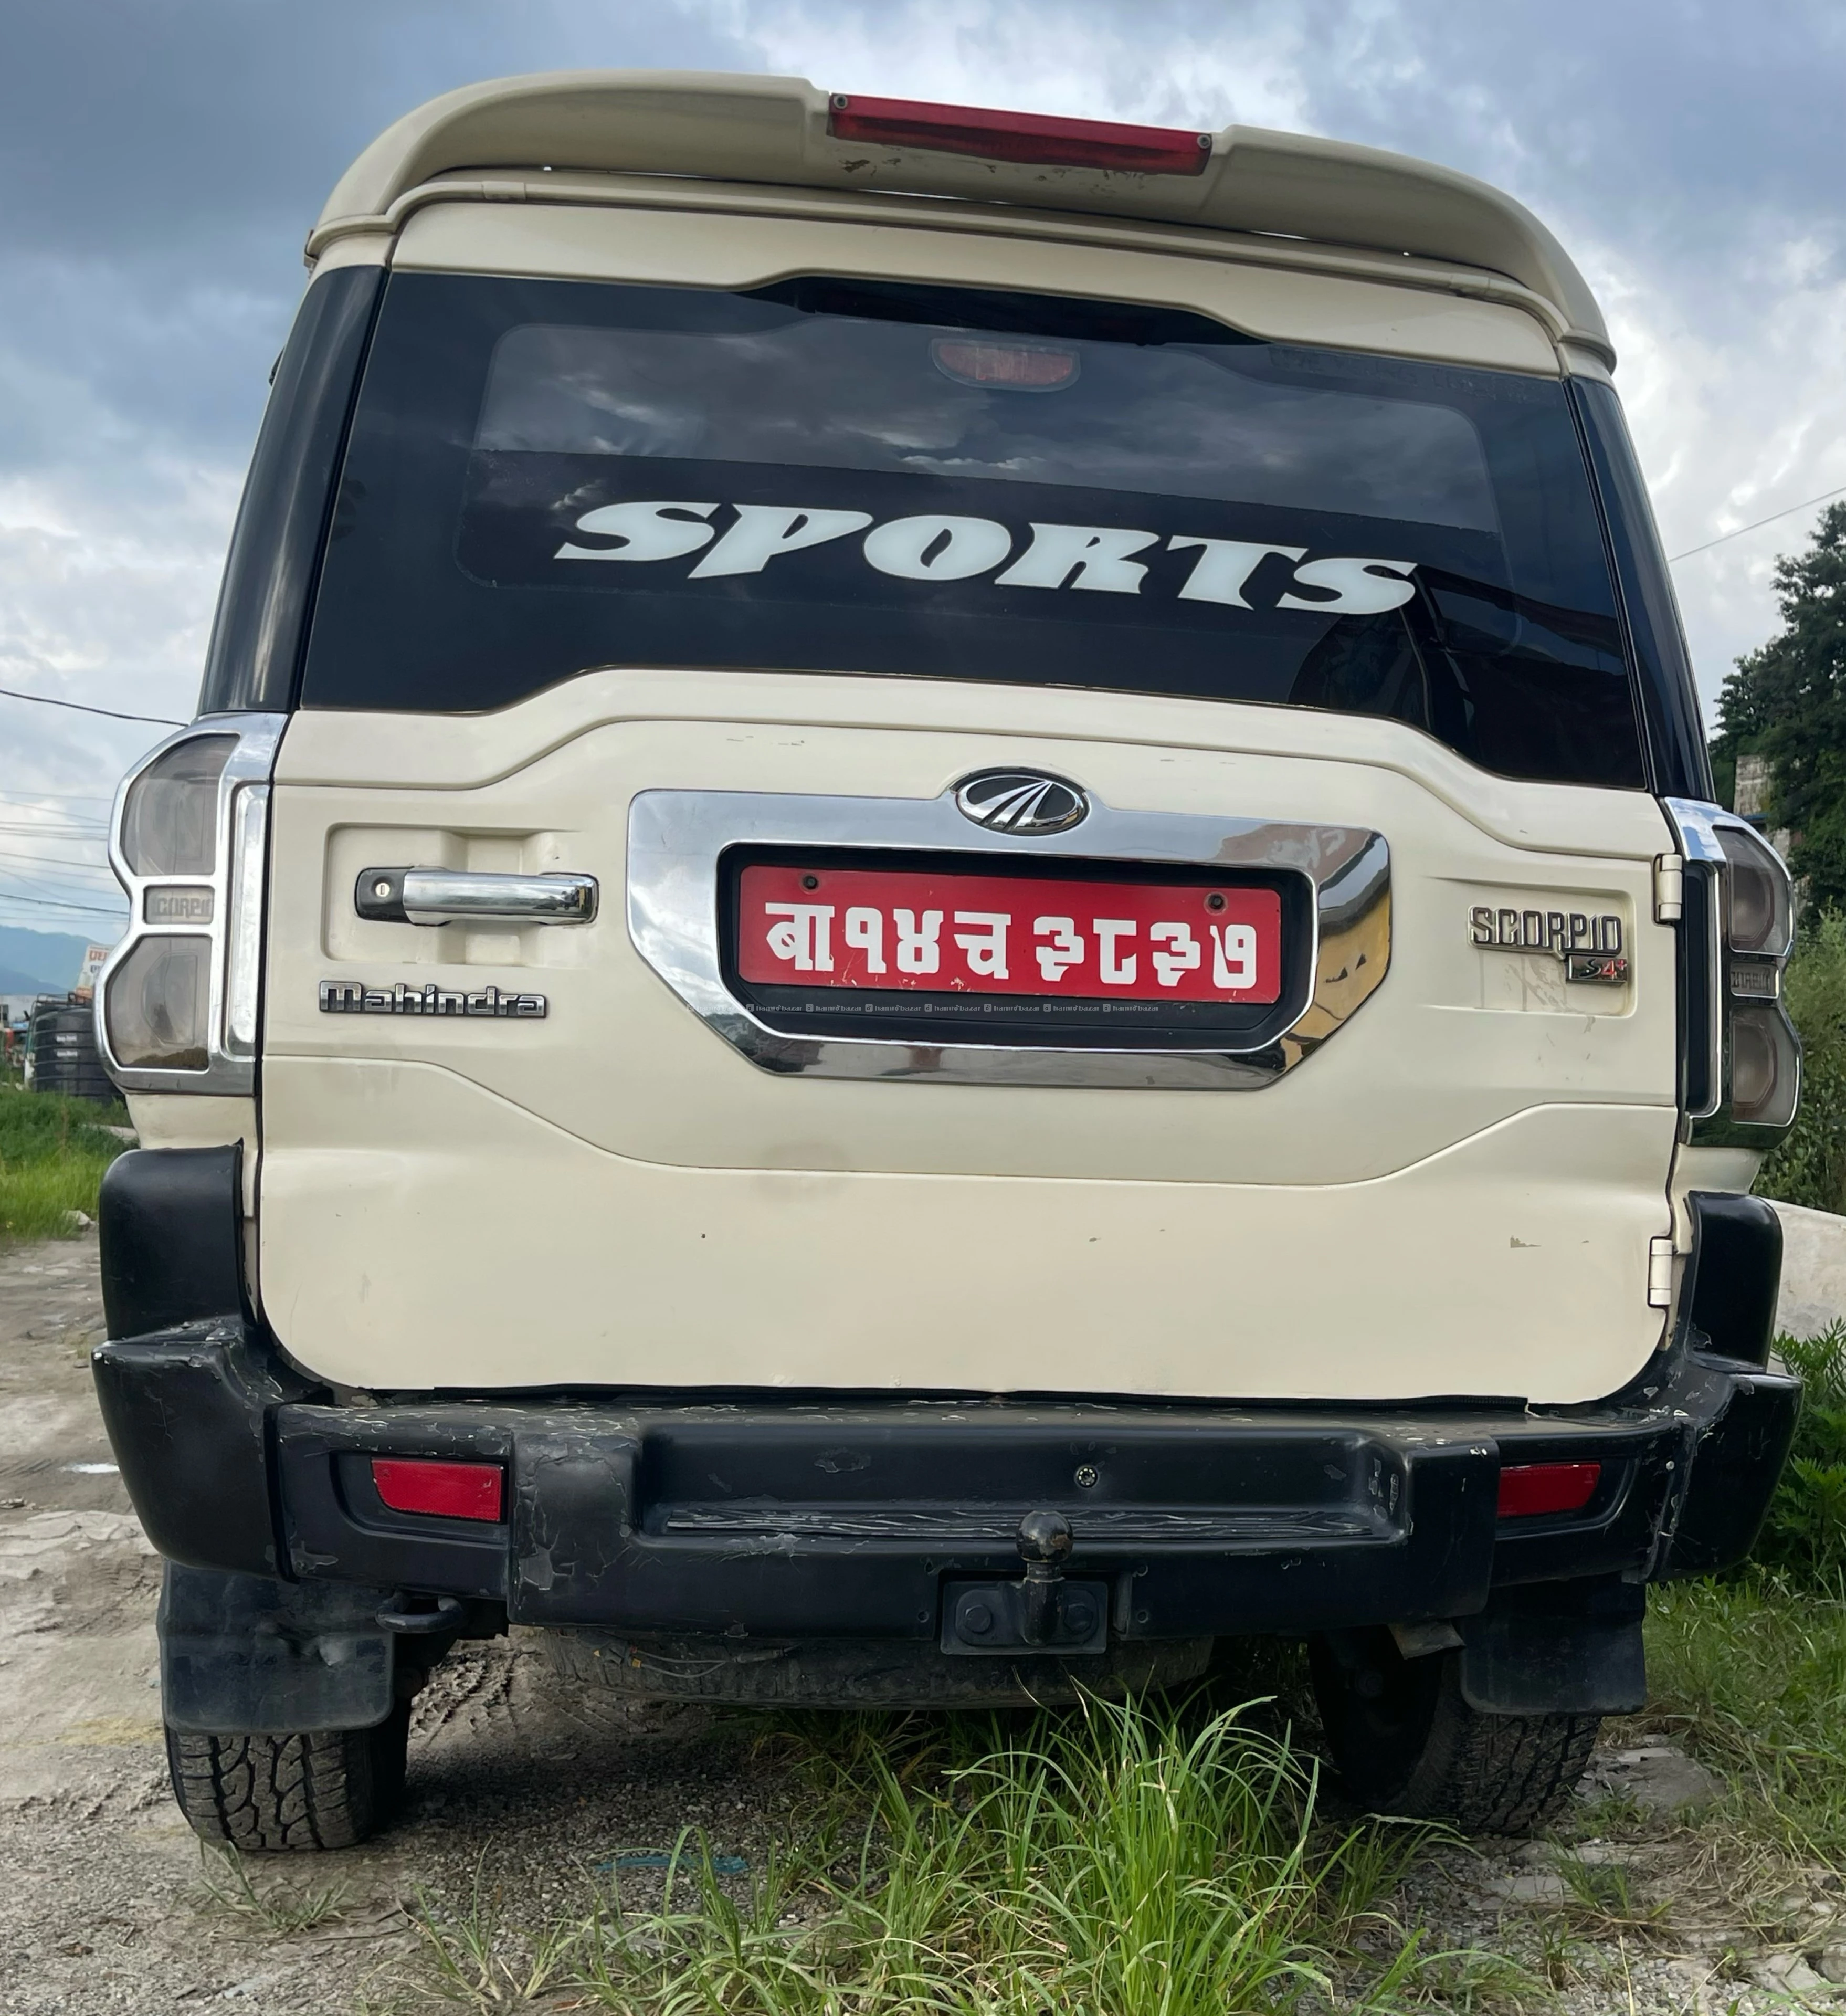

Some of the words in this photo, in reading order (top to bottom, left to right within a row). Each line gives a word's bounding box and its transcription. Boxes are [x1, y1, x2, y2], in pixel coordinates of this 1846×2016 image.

[553, 501, 1419, 615] SPORTS
[1032, 916, 1257, 989] ३८३७
[1468, 905, 1623, 961] SCORPIO
[319, 980, 547, 1018] Mahindra
